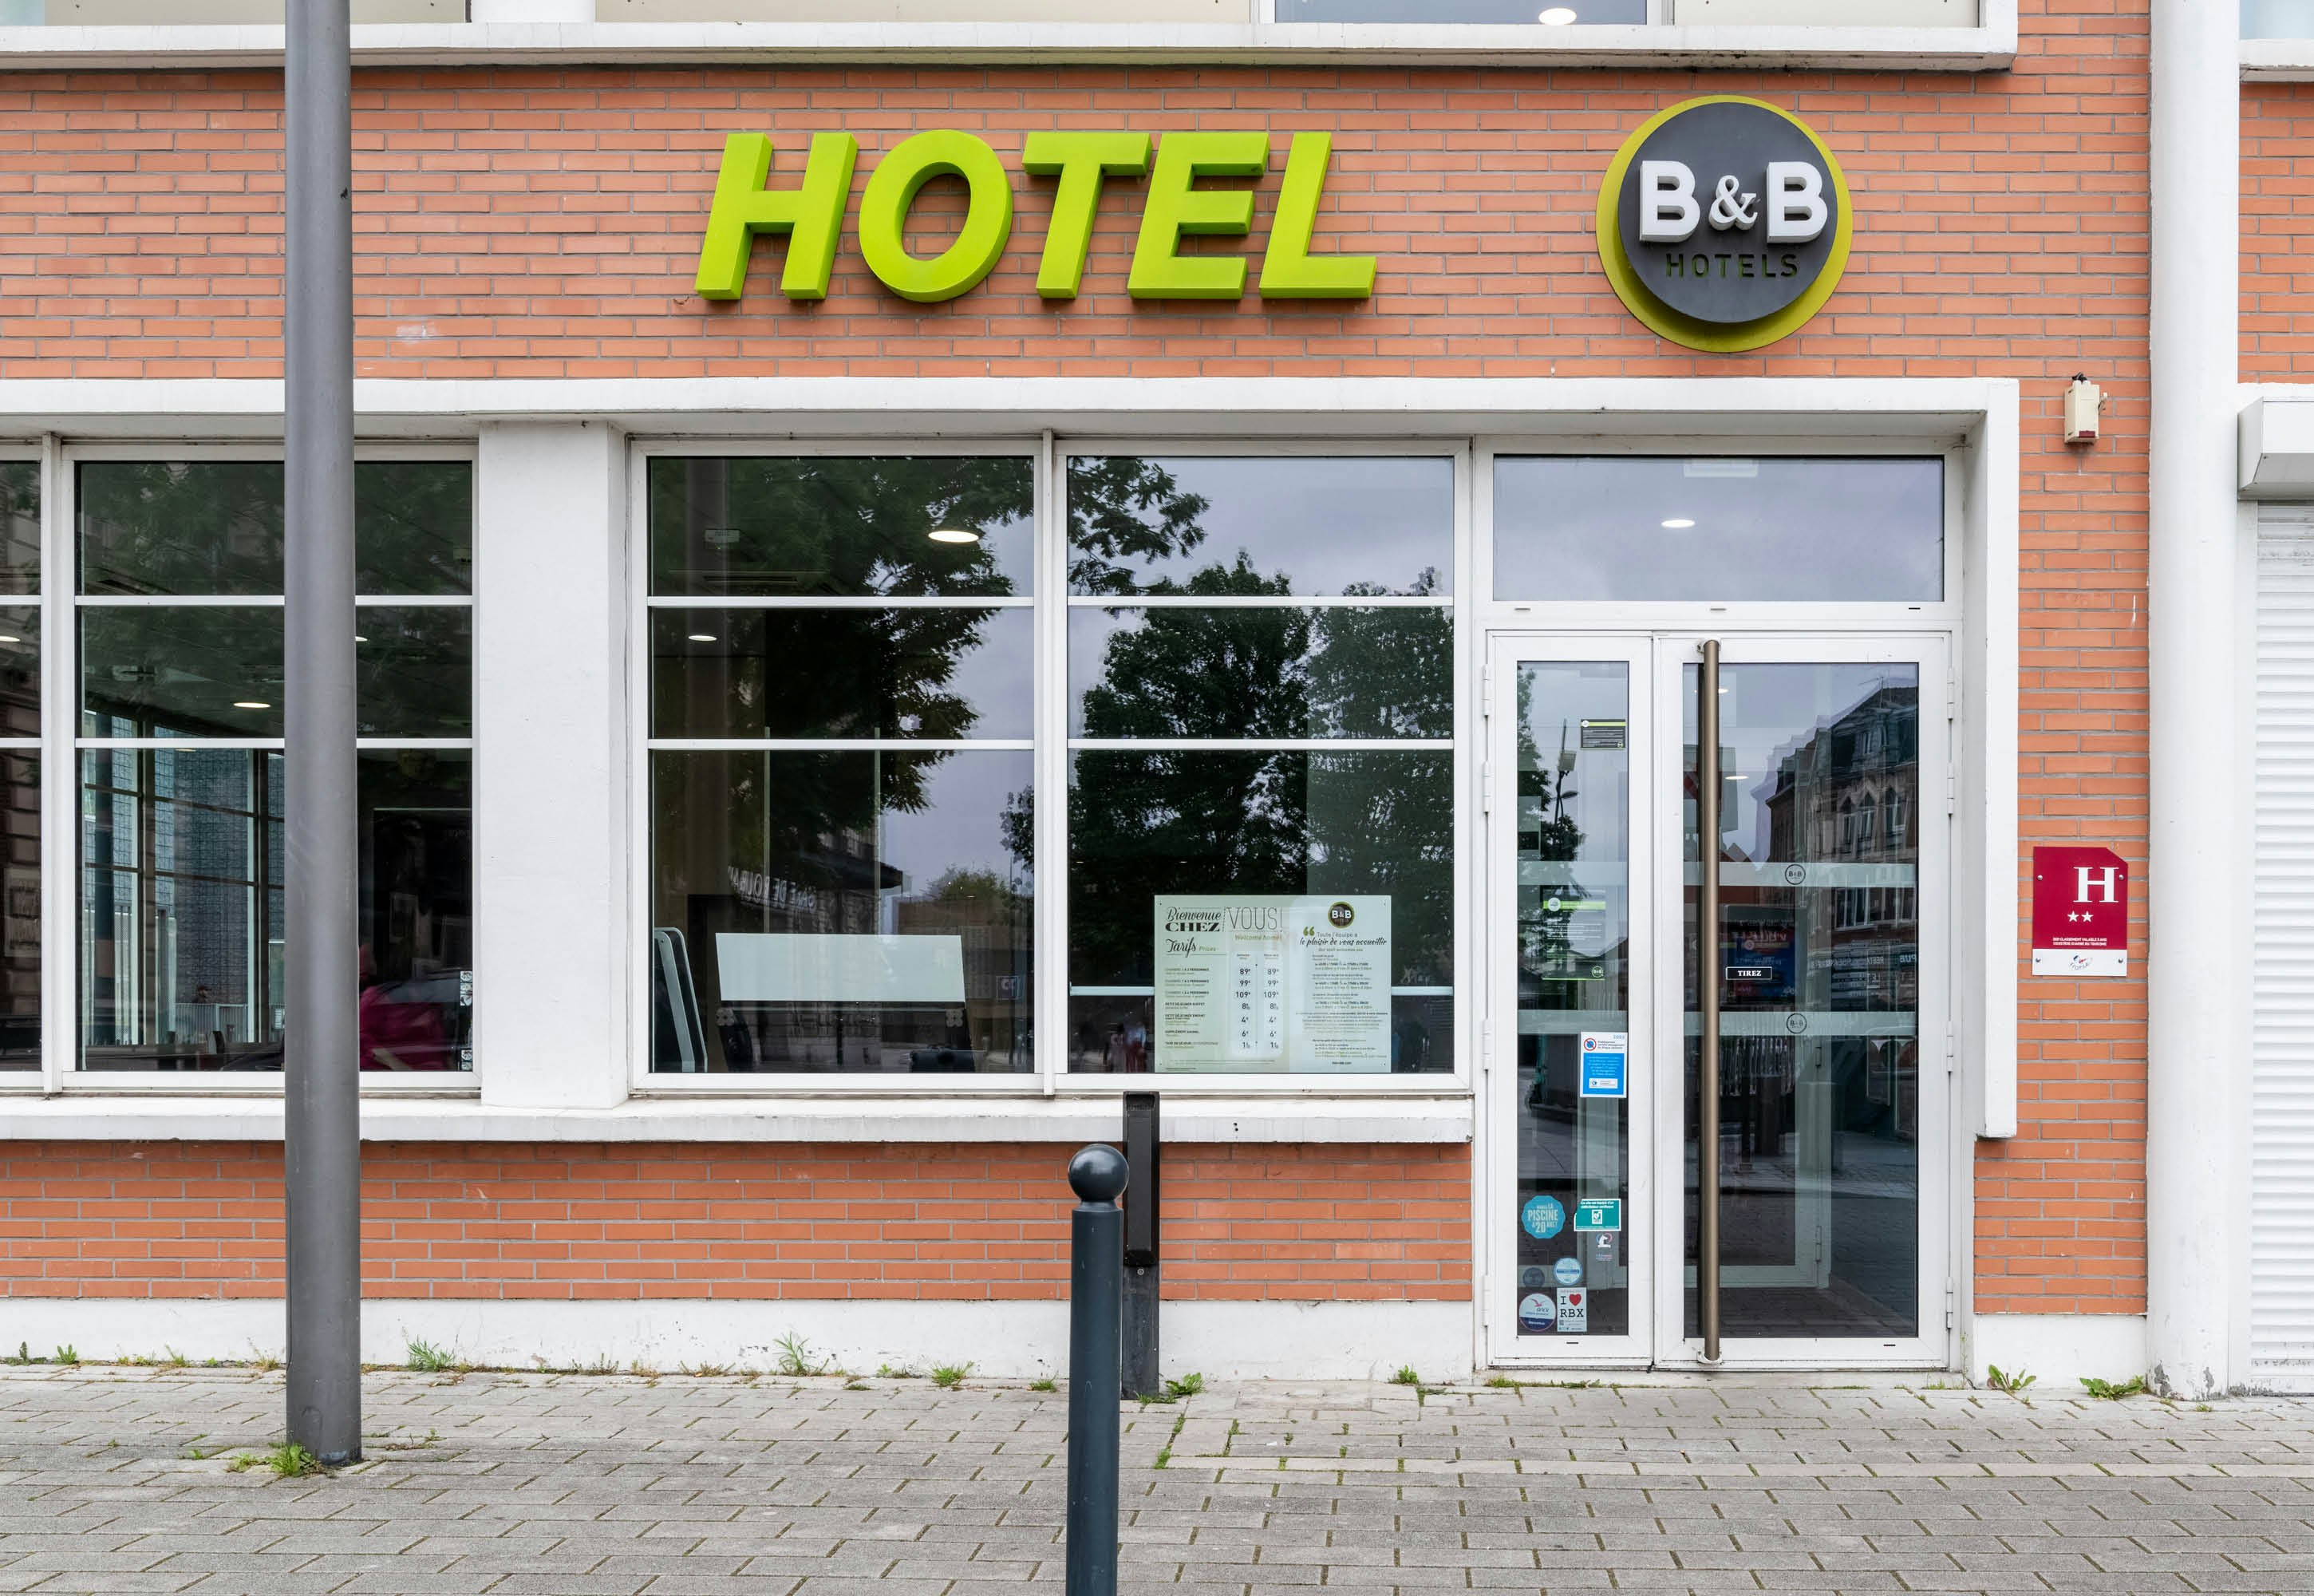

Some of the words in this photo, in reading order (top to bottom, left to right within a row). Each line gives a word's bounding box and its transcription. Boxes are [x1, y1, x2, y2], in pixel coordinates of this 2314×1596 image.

[1639, 160, 1828, 243] B&B
[695, 129, 1376, 302] HOTEL
[1665, 252, 1799, 278] HOTELS
[2073, 867, 2119, 903] H
[1166, 907, 1222, 922] Bienvenue
[1165, 922, 1220, 932] CHEZ
[1166, 937, 1196, 958] Tarifs
[1306, 938, 1329, 948] plaisir
[1527, 1209, 1558, 1221] PISCINE
[1535, 1222, 1546, 1233] 20
[1560, 1295, 1566, 1305] I
[1560, 1308, 1584, 1317] RBX
